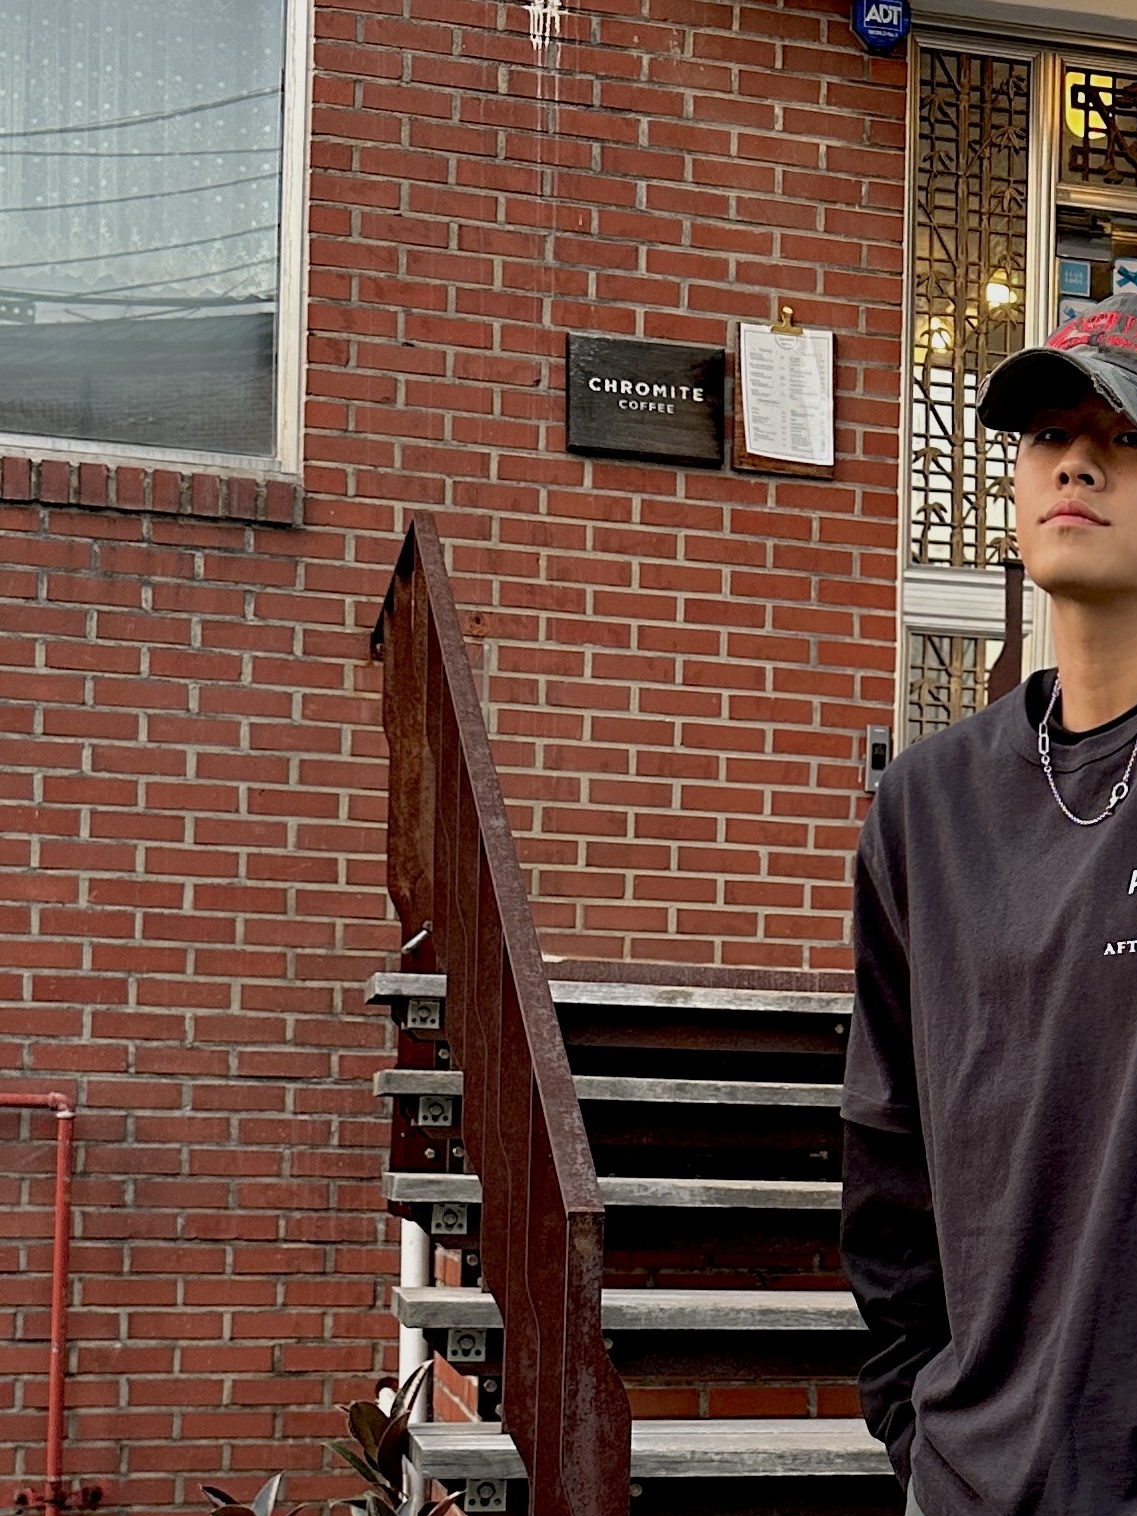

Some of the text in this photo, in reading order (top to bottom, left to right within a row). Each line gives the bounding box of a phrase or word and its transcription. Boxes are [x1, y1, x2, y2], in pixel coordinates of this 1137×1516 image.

[865, 4, 901, 25] ADT
[588, 377, 704, 402] CHROMITE
[618, 399, 675, 414] COFFEE
